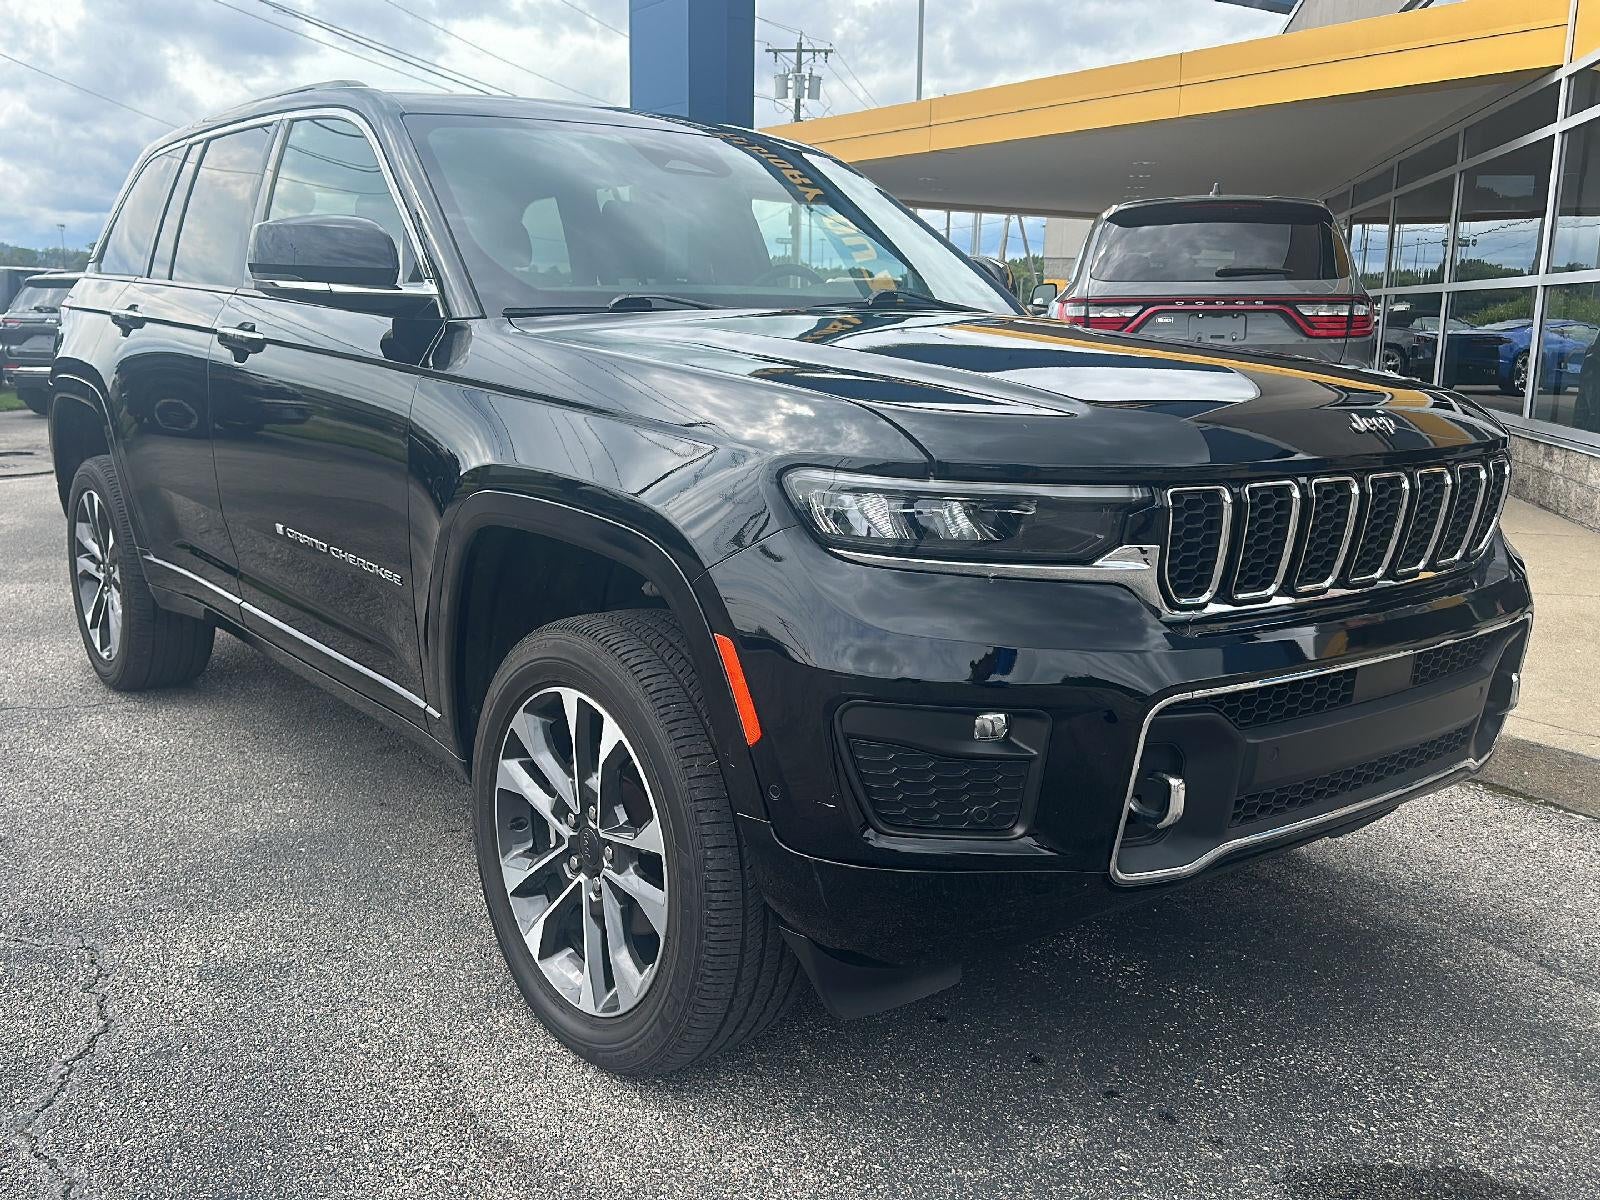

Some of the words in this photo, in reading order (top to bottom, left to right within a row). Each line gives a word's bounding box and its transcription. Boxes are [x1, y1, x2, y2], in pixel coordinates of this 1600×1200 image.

[1349, 410, 1395, 437] Jeep
[286, 527, 327, 552] GRAND
[329, 546, 403, 586] CHEROKEE
